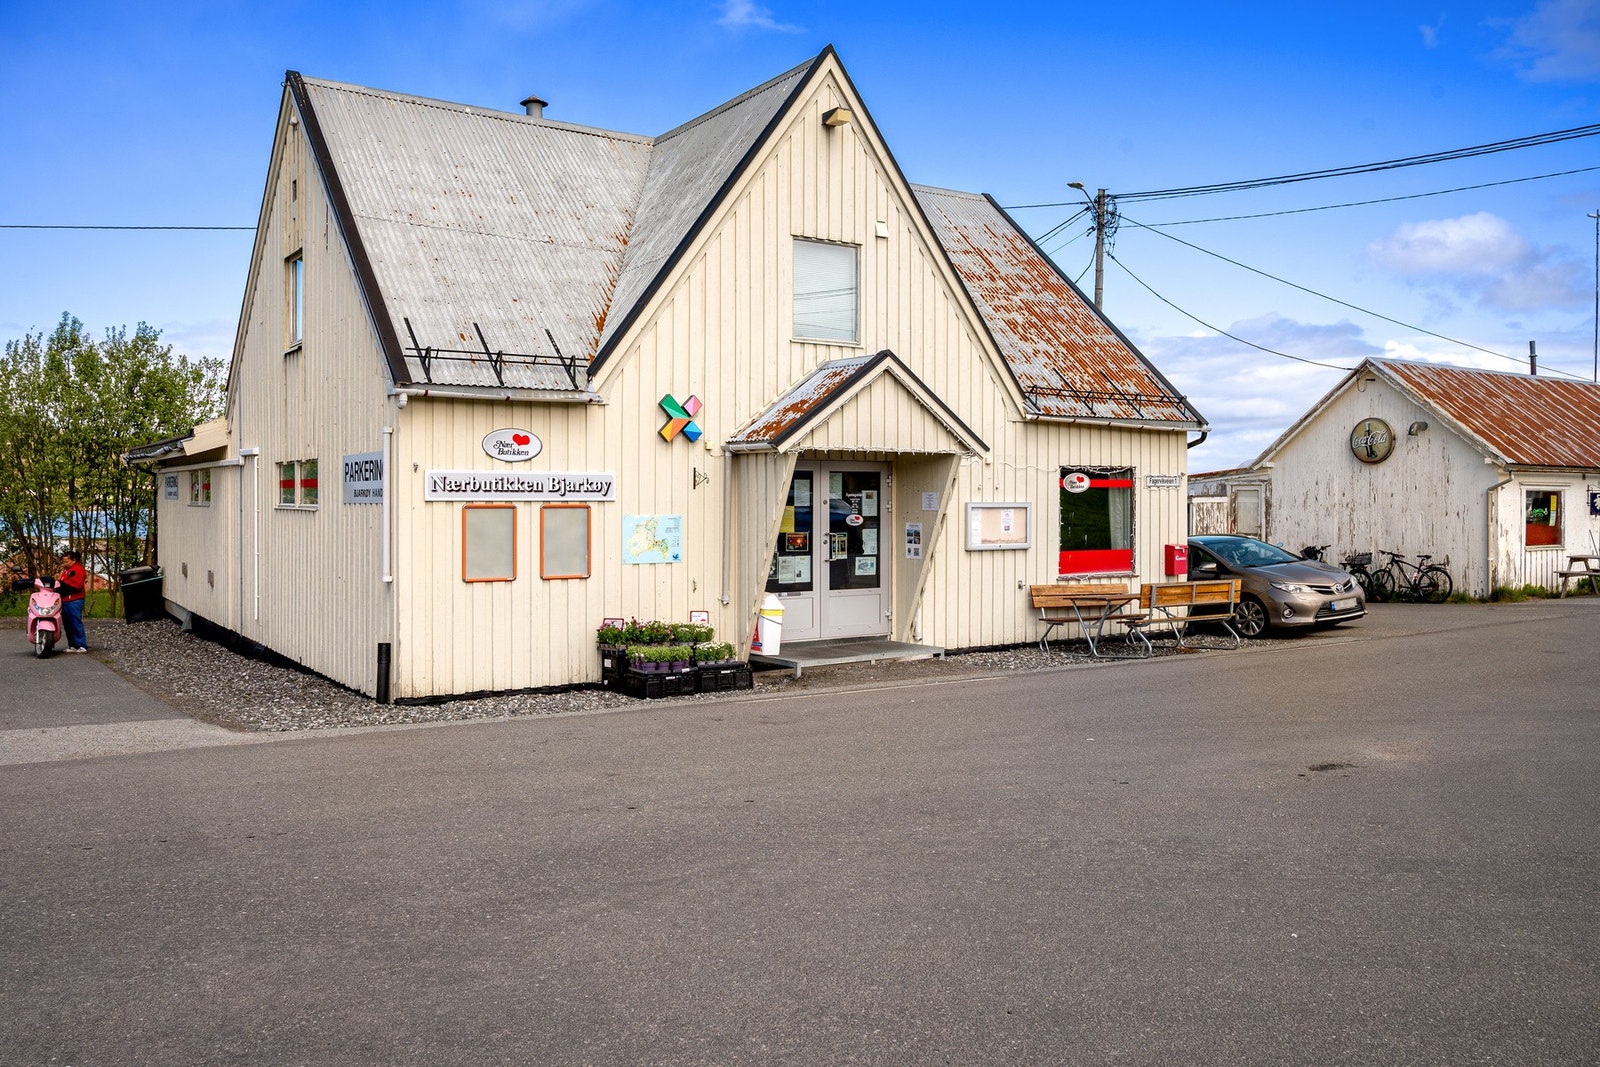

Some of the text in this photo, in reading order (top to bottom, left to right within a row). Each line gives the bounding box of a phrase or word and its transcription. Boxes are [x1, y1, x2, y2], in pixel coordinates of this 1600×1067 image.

[493, 440, 514, 449] Nær
[497, 448, 529, 456] Butikken
[344, 459, 384, 482] PARKERIN
[431, 475, 611, 496] Nærbutikken Bjarkøy
[372, 488, 384, 498] HAND
